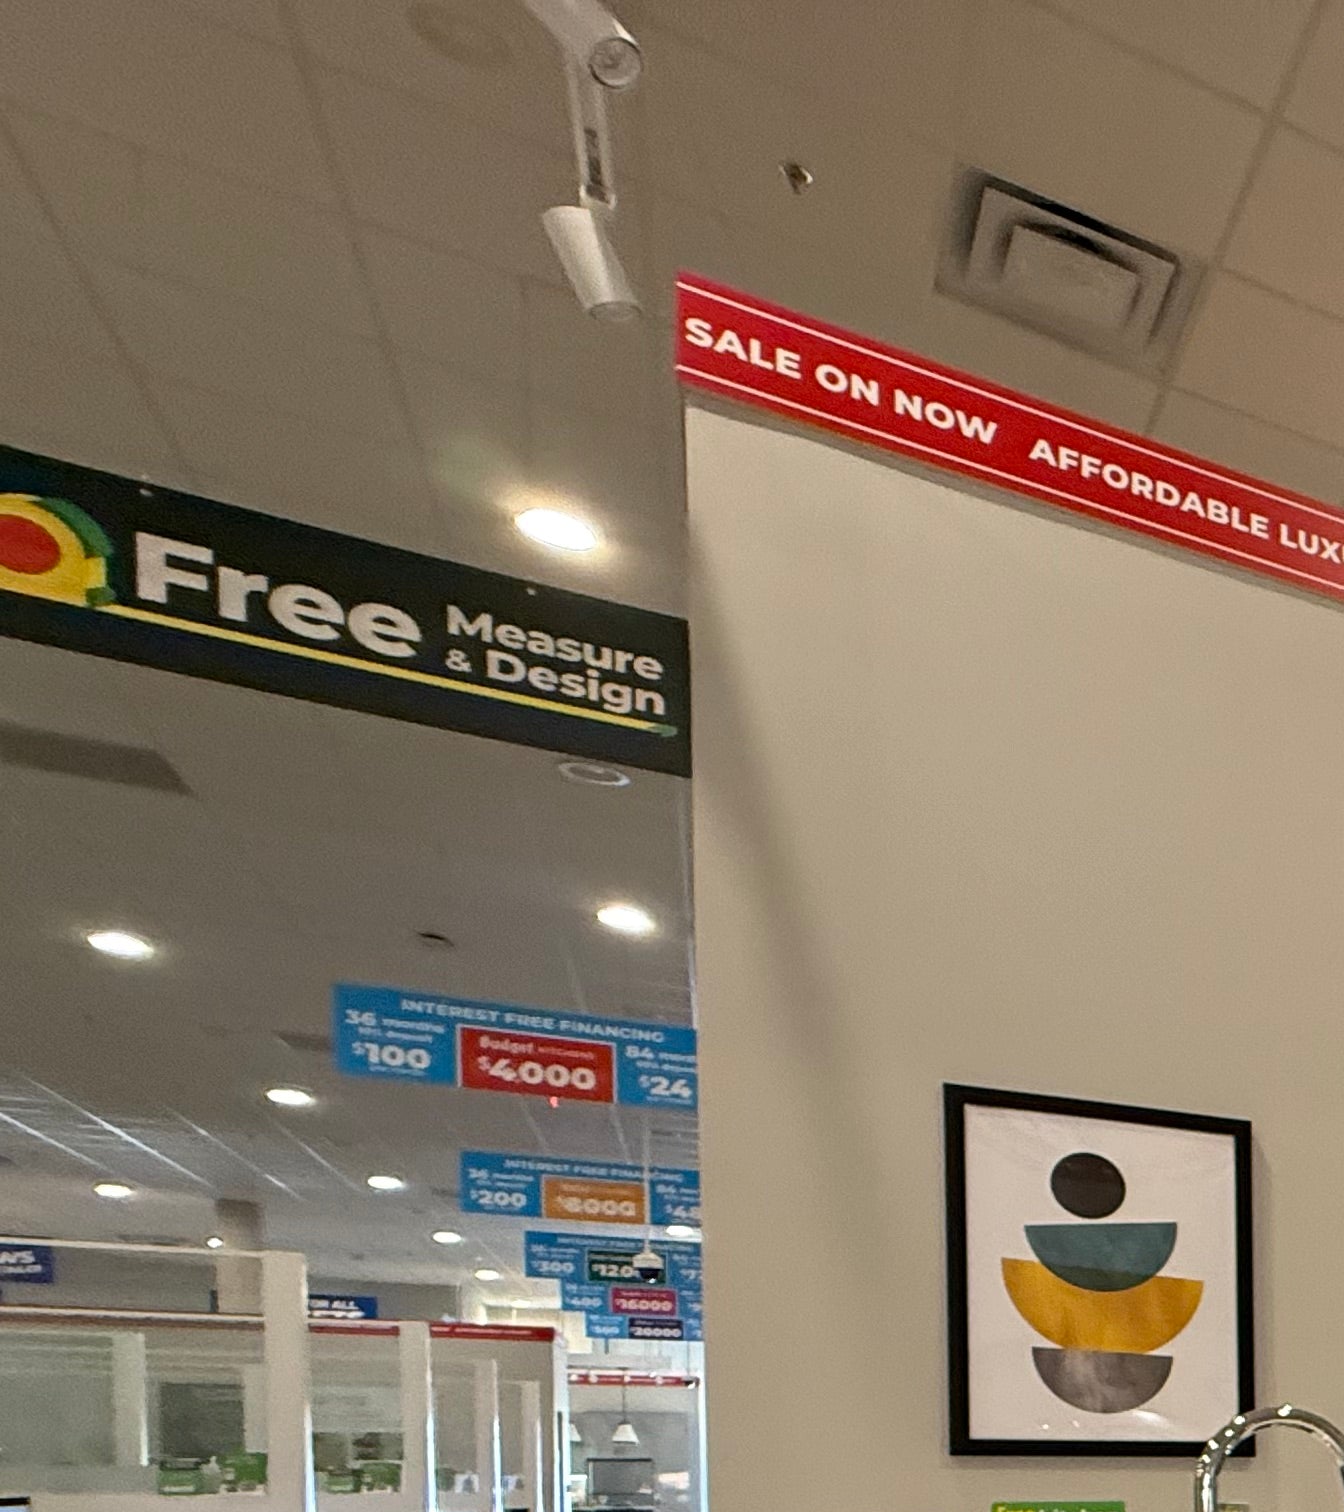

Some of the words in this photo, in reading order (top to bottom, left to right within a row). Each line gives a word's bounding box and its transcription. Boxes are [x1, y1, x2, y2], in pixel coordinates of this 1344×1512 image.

[685, 318, 801, 379] SALE
[815, 364, 879, 406] ON
[894, 389, 998, 444] NOW
[1029, 439, 1269, 539] AFFORDABLE
[134, 530, 421, 659] Free
[446, 605, 665, 682] Measure
[445, 647, 472, 674] &
[487, 647, 667, 716] Design
[401, 999, 500, 1022] INTEREST
[505, 1012, 555, 1029] FREE
[559, 1020, 665, 1043] FINANCING
[352, 1042, 432, 1069] $100
[477, 1056, 597, 1090] $4000
[639, 1074, 692, 1098] $24
[470, 1190, 527, 1209] $200
